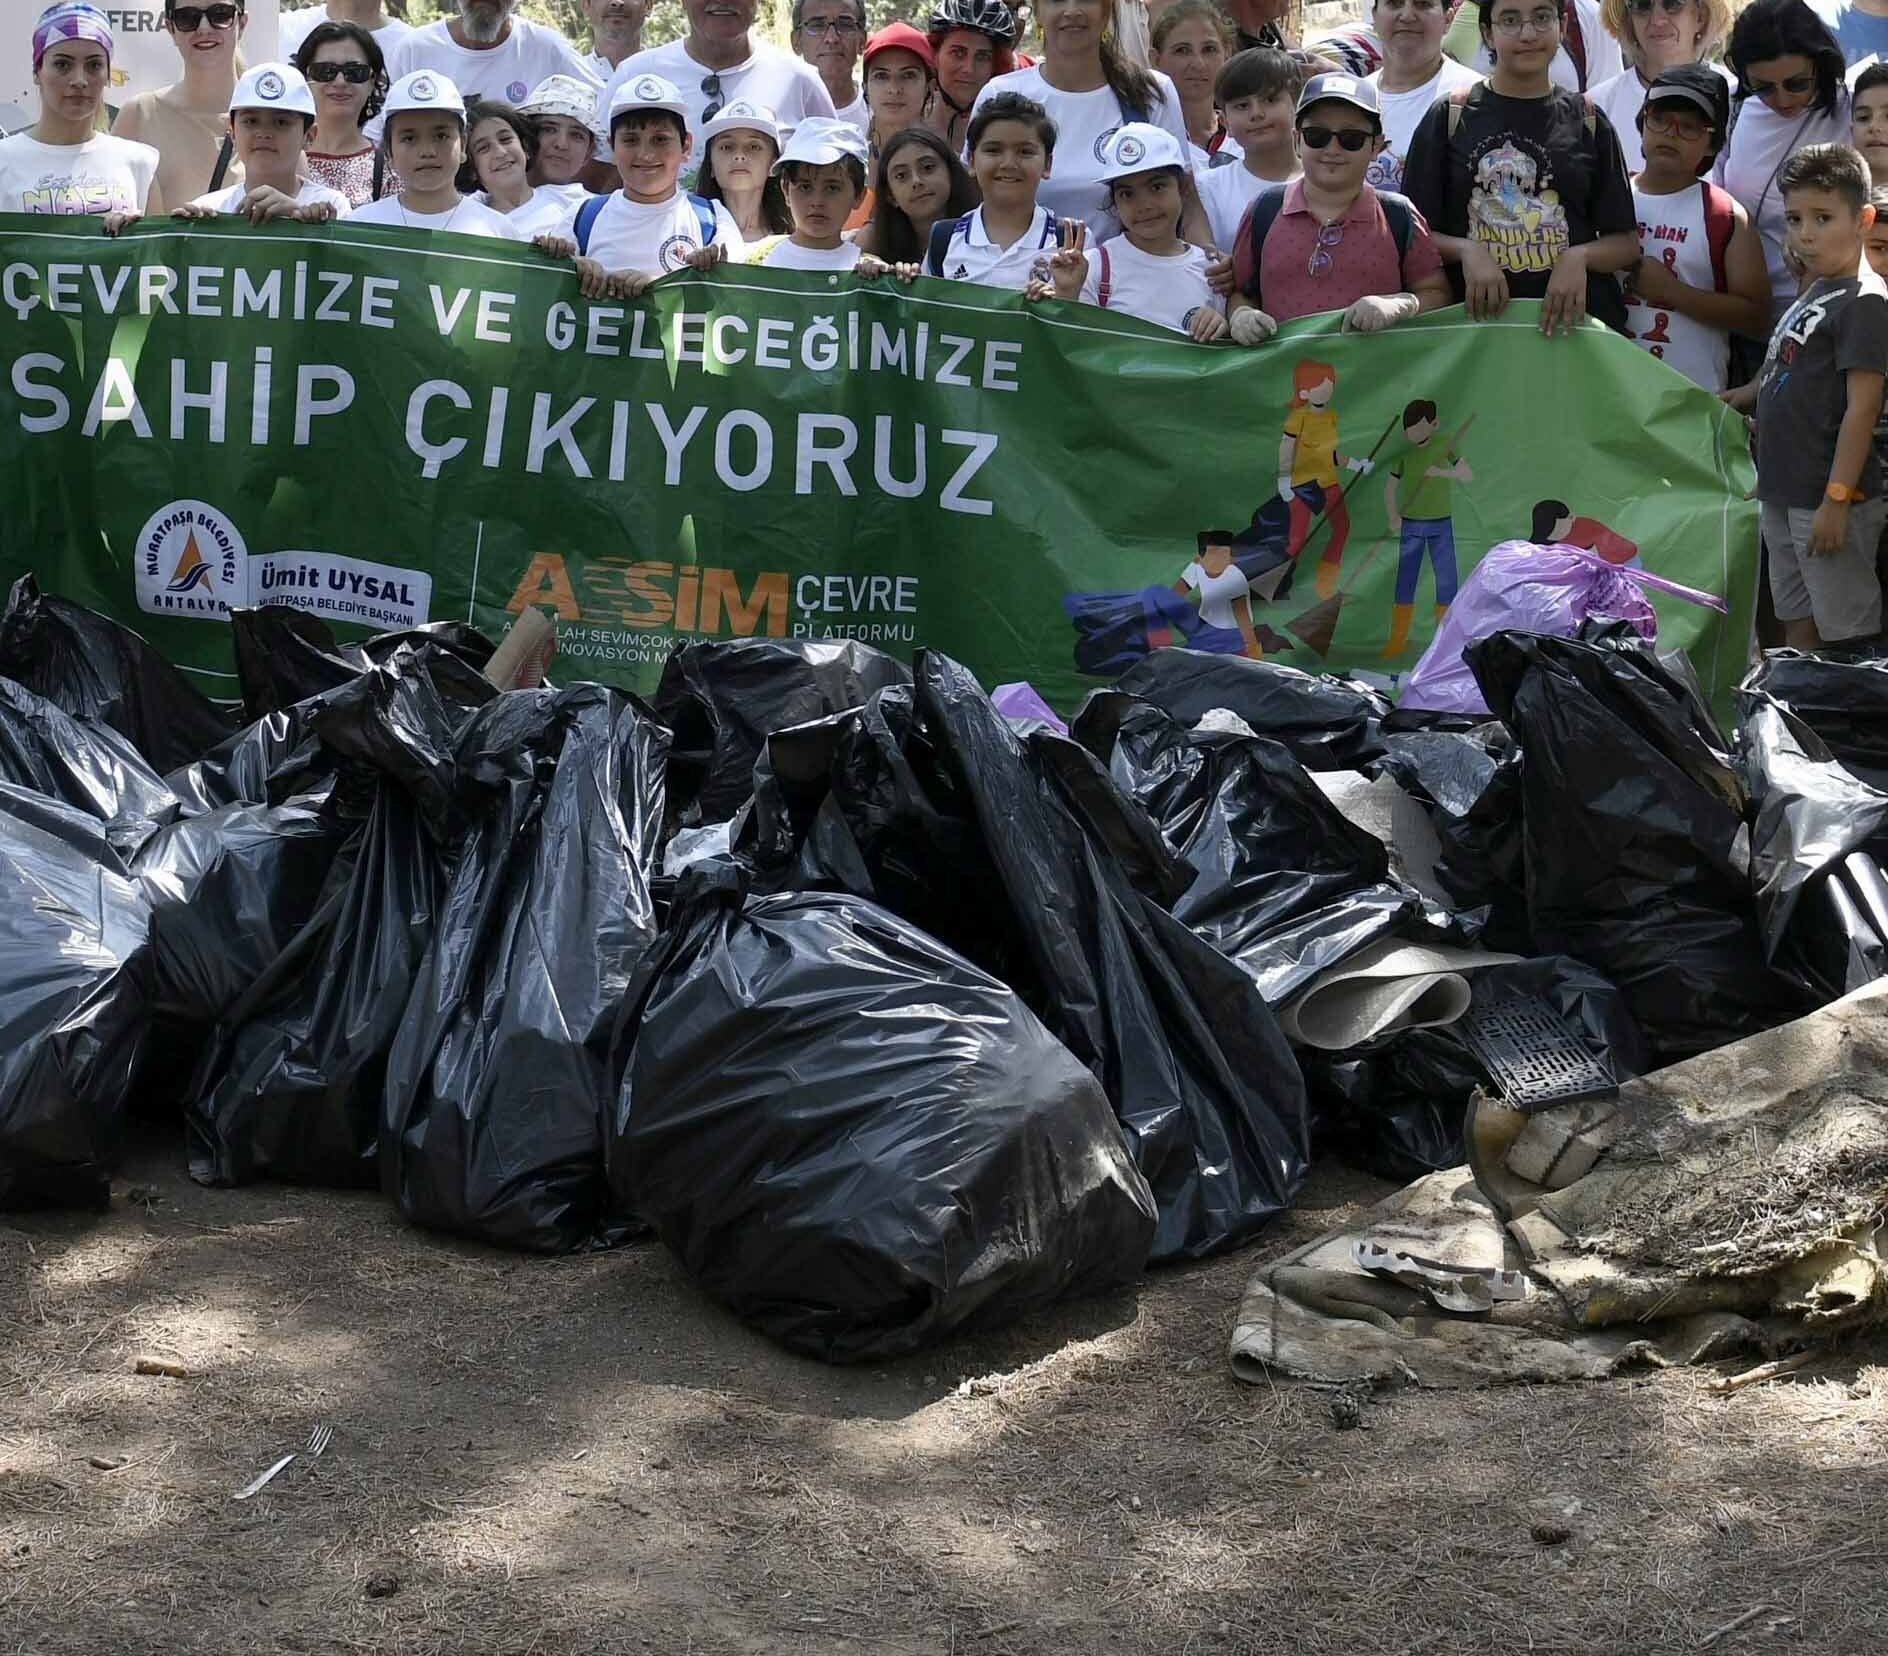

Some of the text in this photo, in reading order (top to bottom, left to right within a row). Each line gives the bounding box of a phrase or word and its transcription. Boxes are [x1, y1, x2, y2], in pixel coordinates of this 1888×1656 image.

[110, 11, 169, 32] FERA
[2, 259, 1024, 392] ÇEVREMİZE VE GELECEĞİMİZE
[11, 346, 999, 515] SAHİP ÇIKIYORUZ
[147, 510, 194, 576] MURATPAŞA
[154, 594, 230, 613] ANTALYA
[261, 561, 416, 607] Ümit UYSAL
[796, 574, 920, 618] ÇEVRE
[317, 597, 367, 617] BELEDİYE
[368, 607, 414, 627] BAŞKANI
[590, 629, 674, 650] SEVİMÇOK
